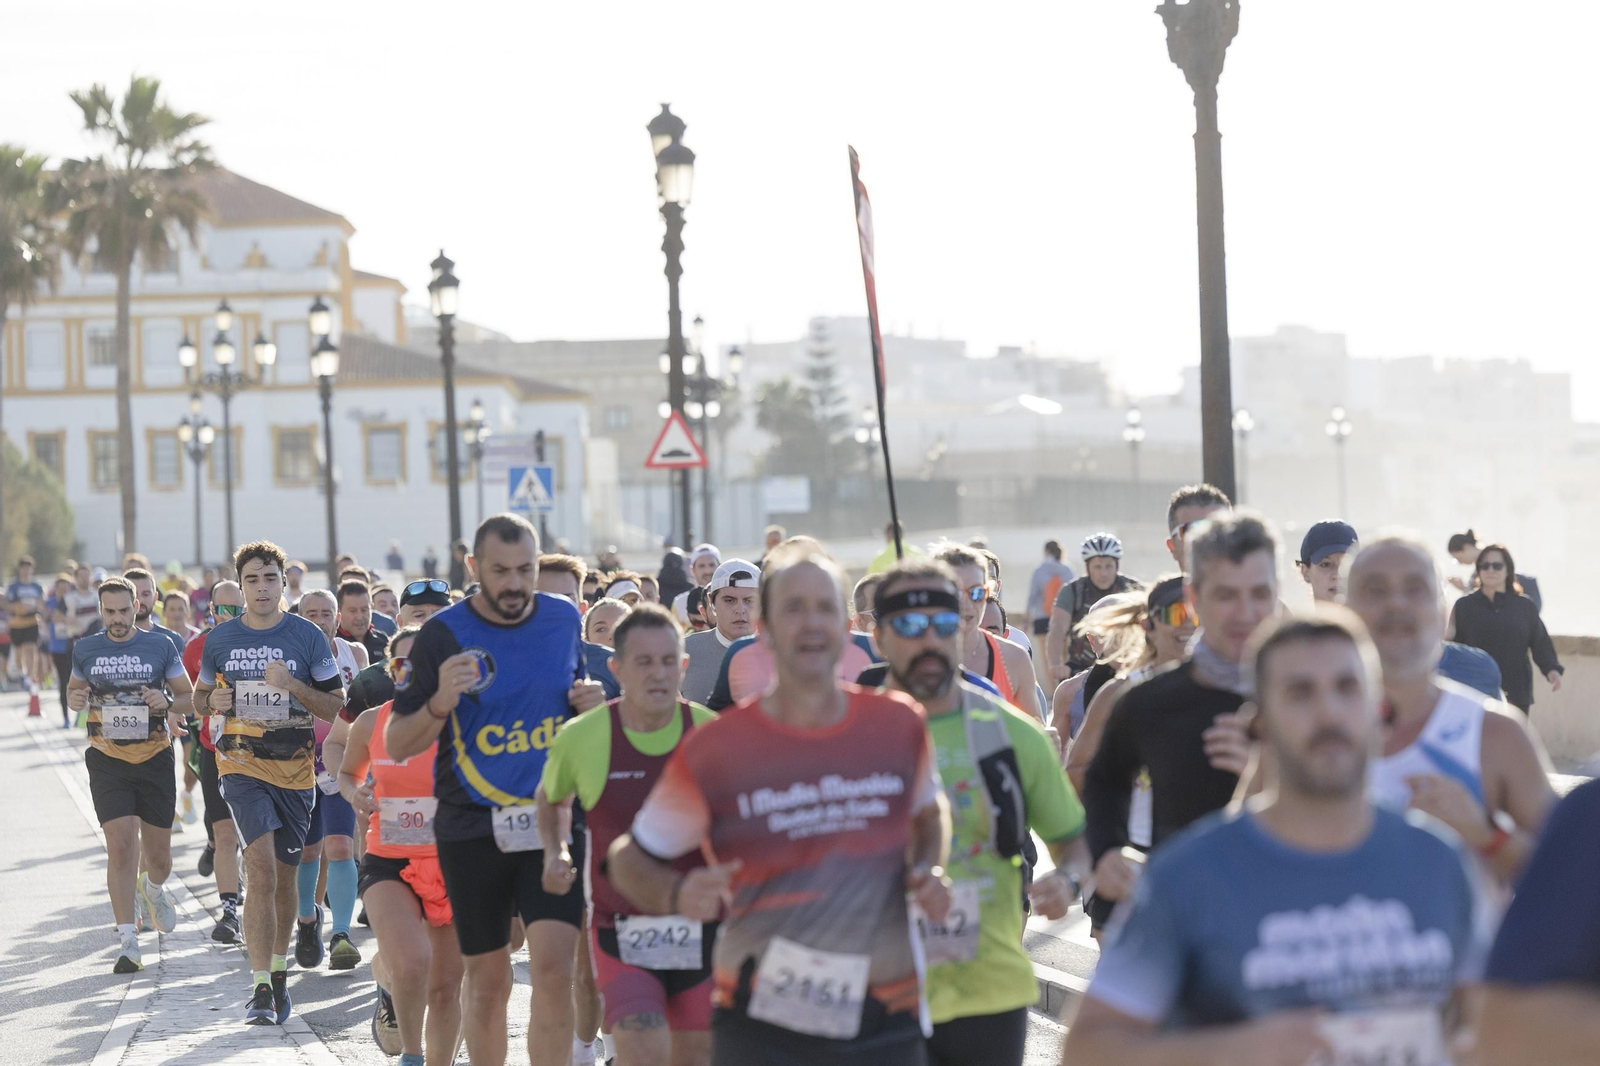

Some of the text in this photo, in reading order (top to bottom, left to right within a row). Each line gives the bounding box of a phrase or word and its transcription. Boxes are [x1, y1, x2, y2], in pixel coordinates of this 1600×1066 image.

[95, 655, 141, 666] media
[230, 646, 283, 660] media
[90, 661, 153, 675] maraton
[243, 691, 282, 706] 1112
[113, 716, 138, 728] 853
[476, 715, 564, 756] Cádi
[400, 811, 424, 829] 30
[504, 813, 537, 831] 19
[629, 925, 691, 951] 2242
